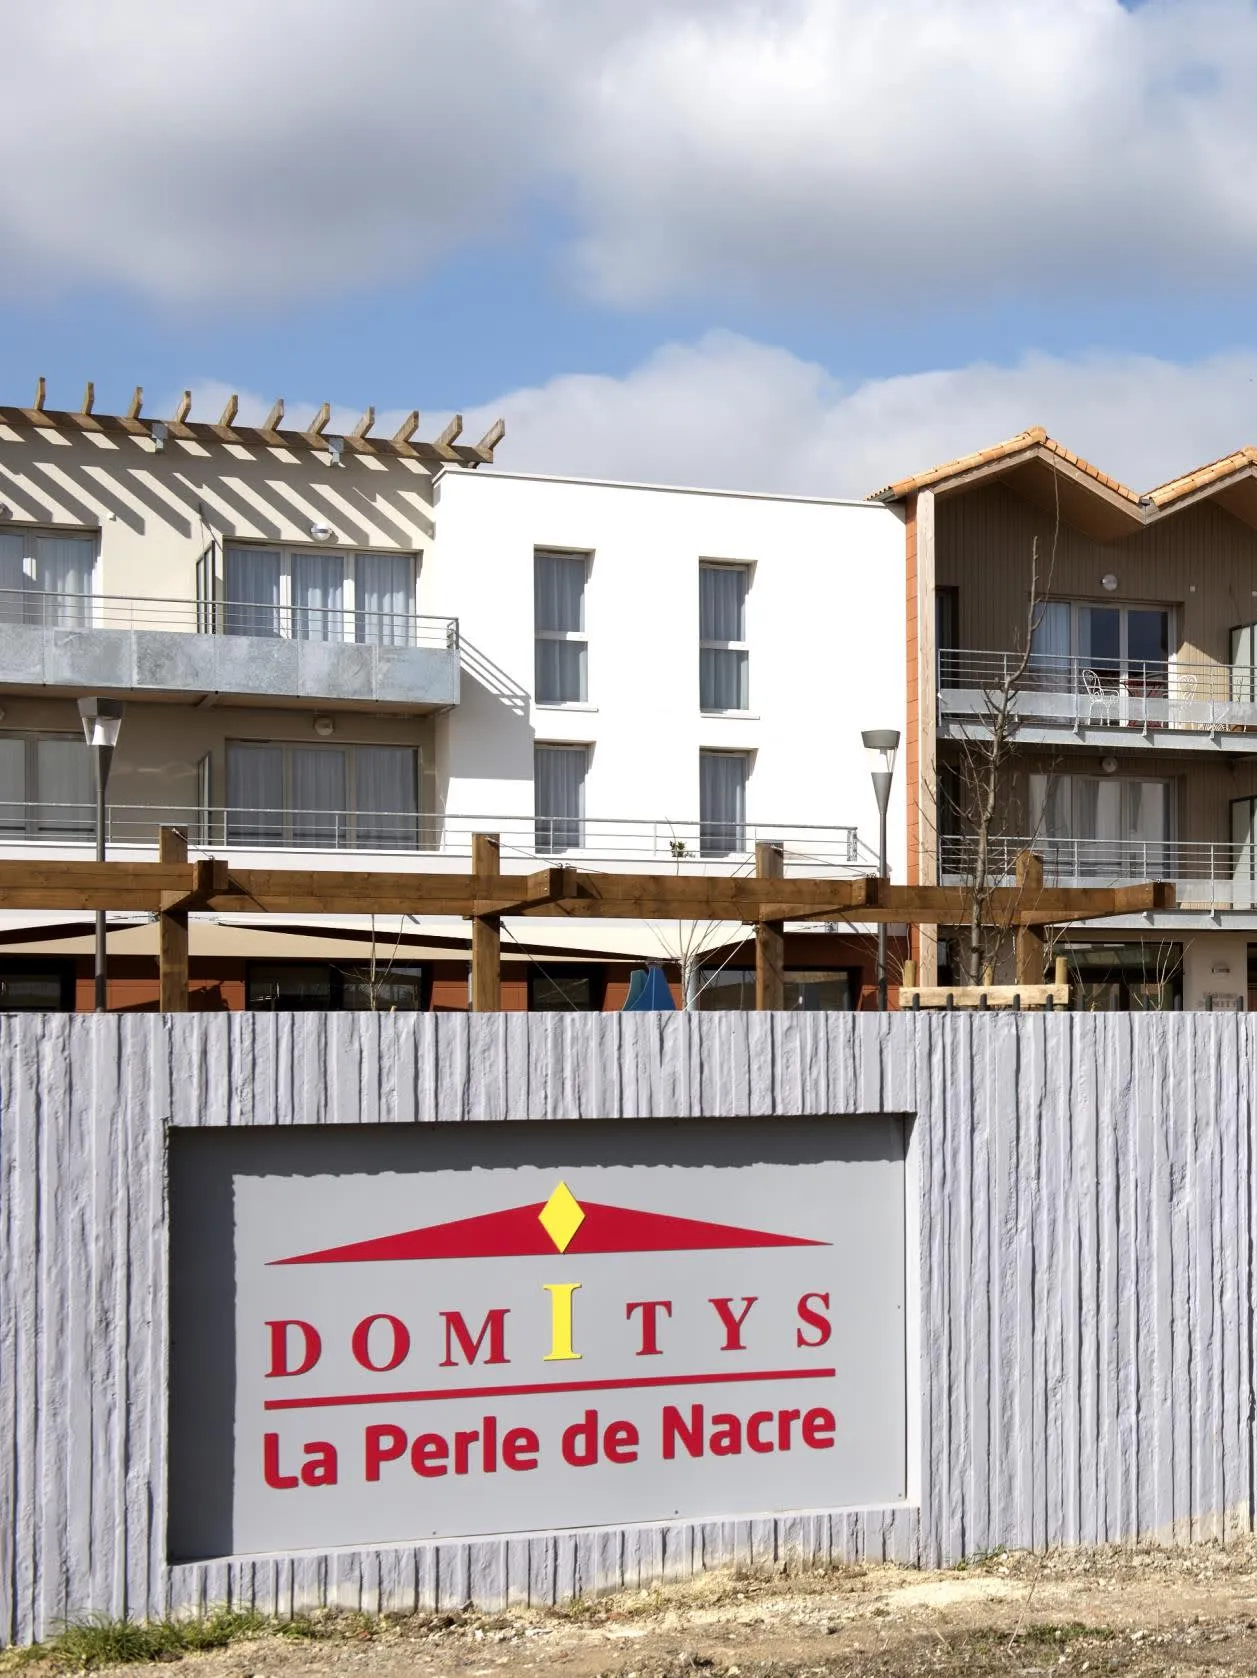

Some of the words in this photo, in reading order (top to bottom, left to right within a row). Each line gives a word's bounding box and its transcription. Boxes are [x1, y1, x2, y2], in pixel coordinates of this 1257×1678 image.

[265, 1284, 831, 1377] DOMITYS
[263, 1432, 337, 1489] La
[365, 1415, 540, 1482] Perle
[561, 1409, 639, 1467] de
[662, 1403, 836, 1460] Nacre
